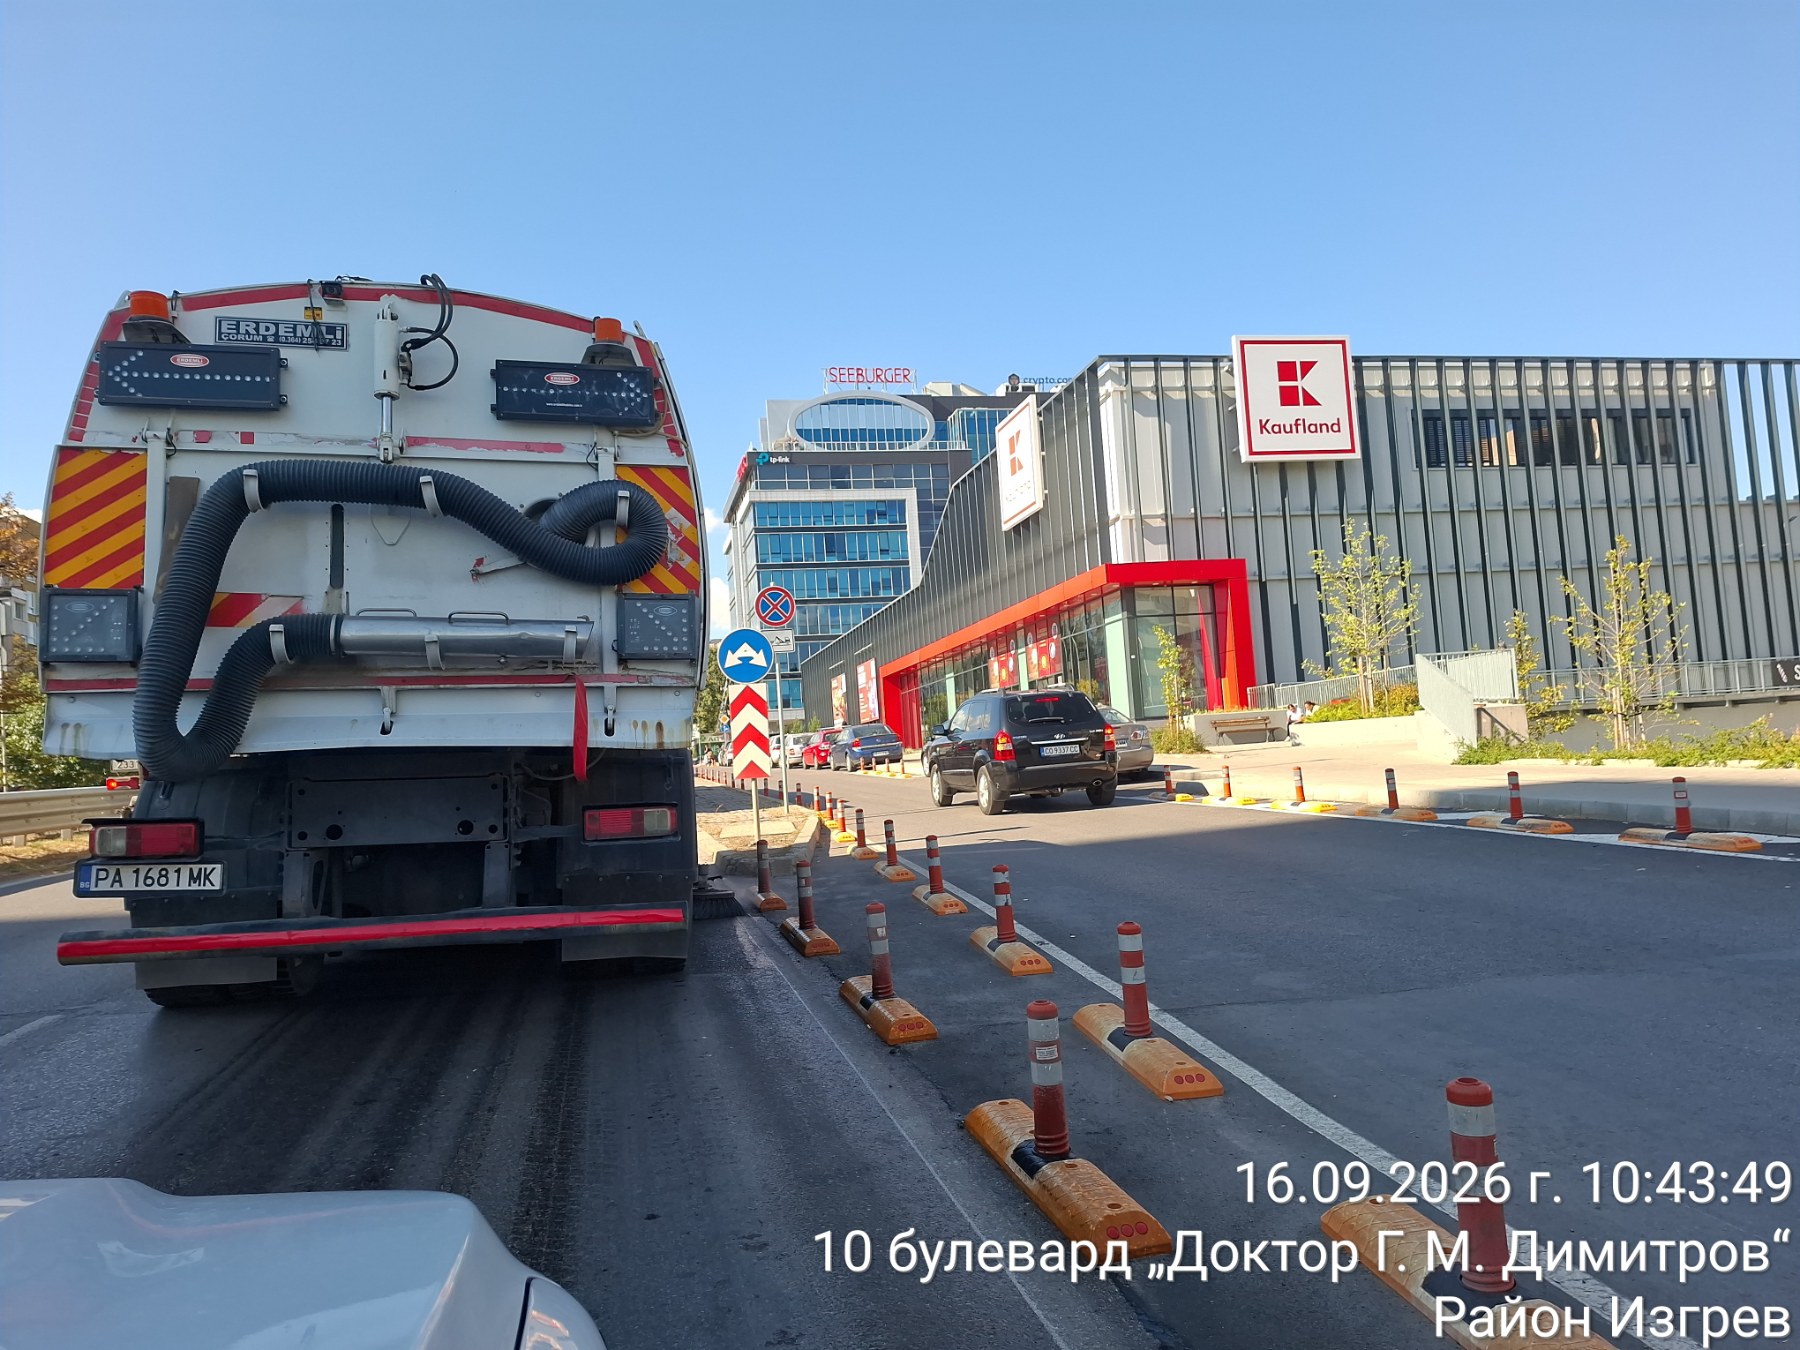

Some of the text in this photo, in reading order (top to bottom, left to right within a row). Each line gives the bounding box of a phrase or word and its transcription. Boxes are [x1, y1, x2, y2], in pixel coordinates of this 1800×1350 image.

[221, 333, 263, 342] ÇORUM
[828, 367, 912, 383] SEEBURGER
[1258, 417, 1342, 435] Kaufland
[770, 455, 790, 464] tp-link
[94, 867, 217, 888] PA 1681 MK
[79, 881, 91, 889] BG
